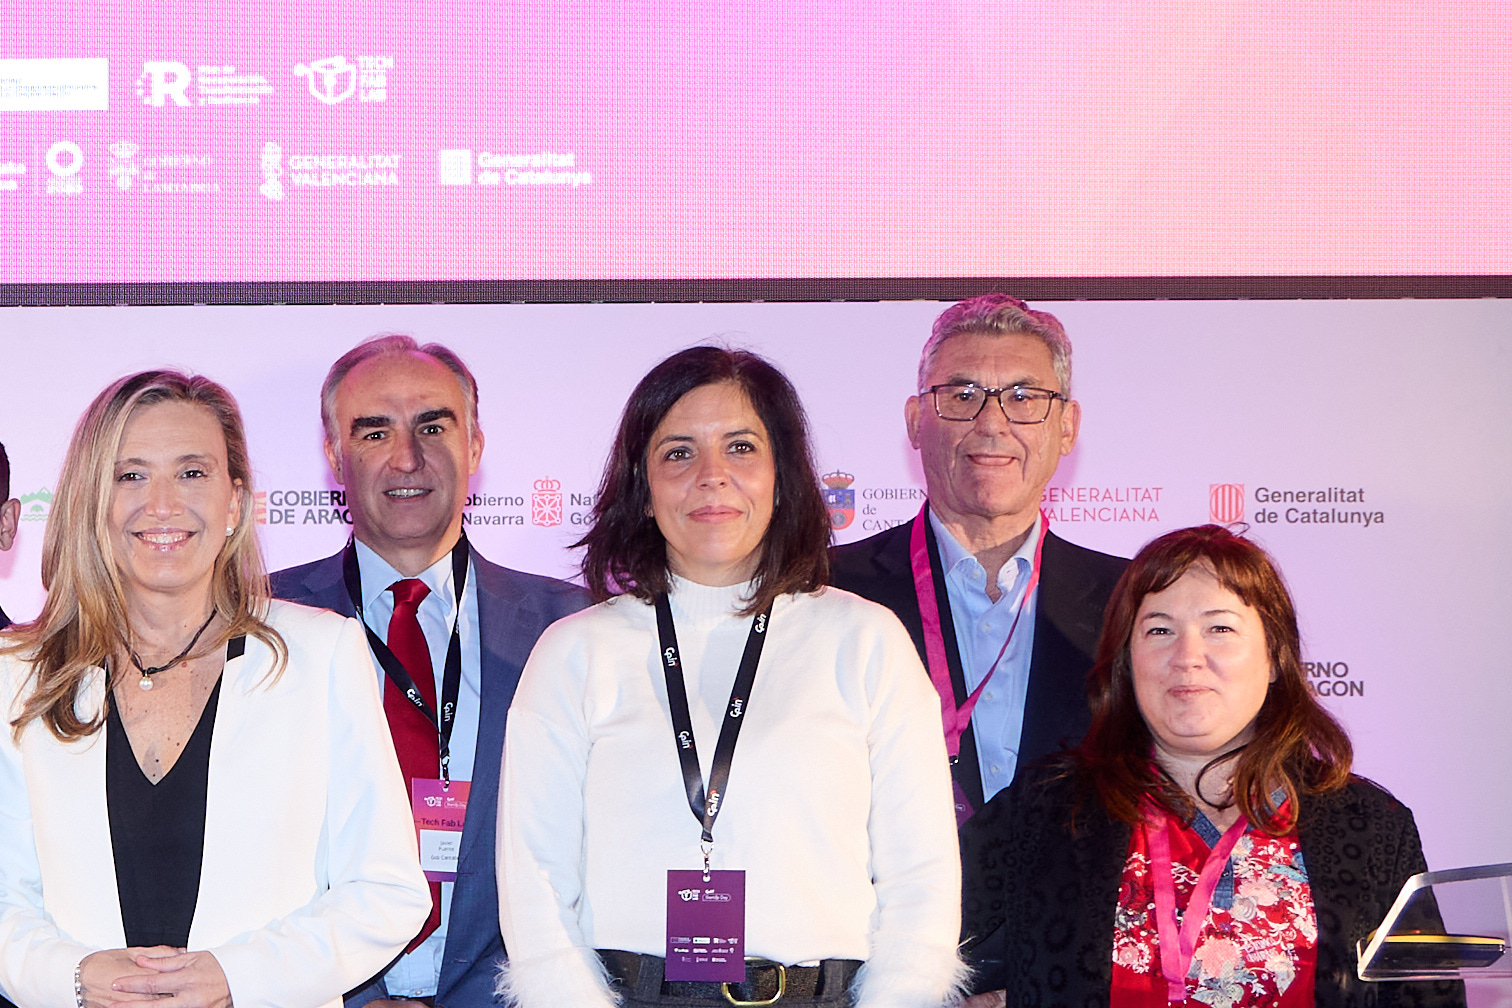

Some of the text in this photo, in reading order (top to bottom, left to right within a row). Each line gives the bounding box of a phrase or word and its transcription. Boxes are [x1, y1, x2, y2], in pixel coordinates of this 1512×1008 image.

[289, 155, 401, 169] GENERALITAT
[478, 152, 574, 167] Generalitat
[291, 171, 399, 186] VALENCIANA
[478, 168, 592, 187] de Catalunya
[464, 493, 524, 506] obierno
[862, 488, 928, 500] GOBIERN
[1254, 487, 1365, 503] Generalitat
[269, 509, 295, 525] DE
[862, 504, 877, 515] de
[1254, 507, 1385, 528] de Catalunya
[421, 817, 440, 826] Tech
[441, 819, 456, 827] Fab
